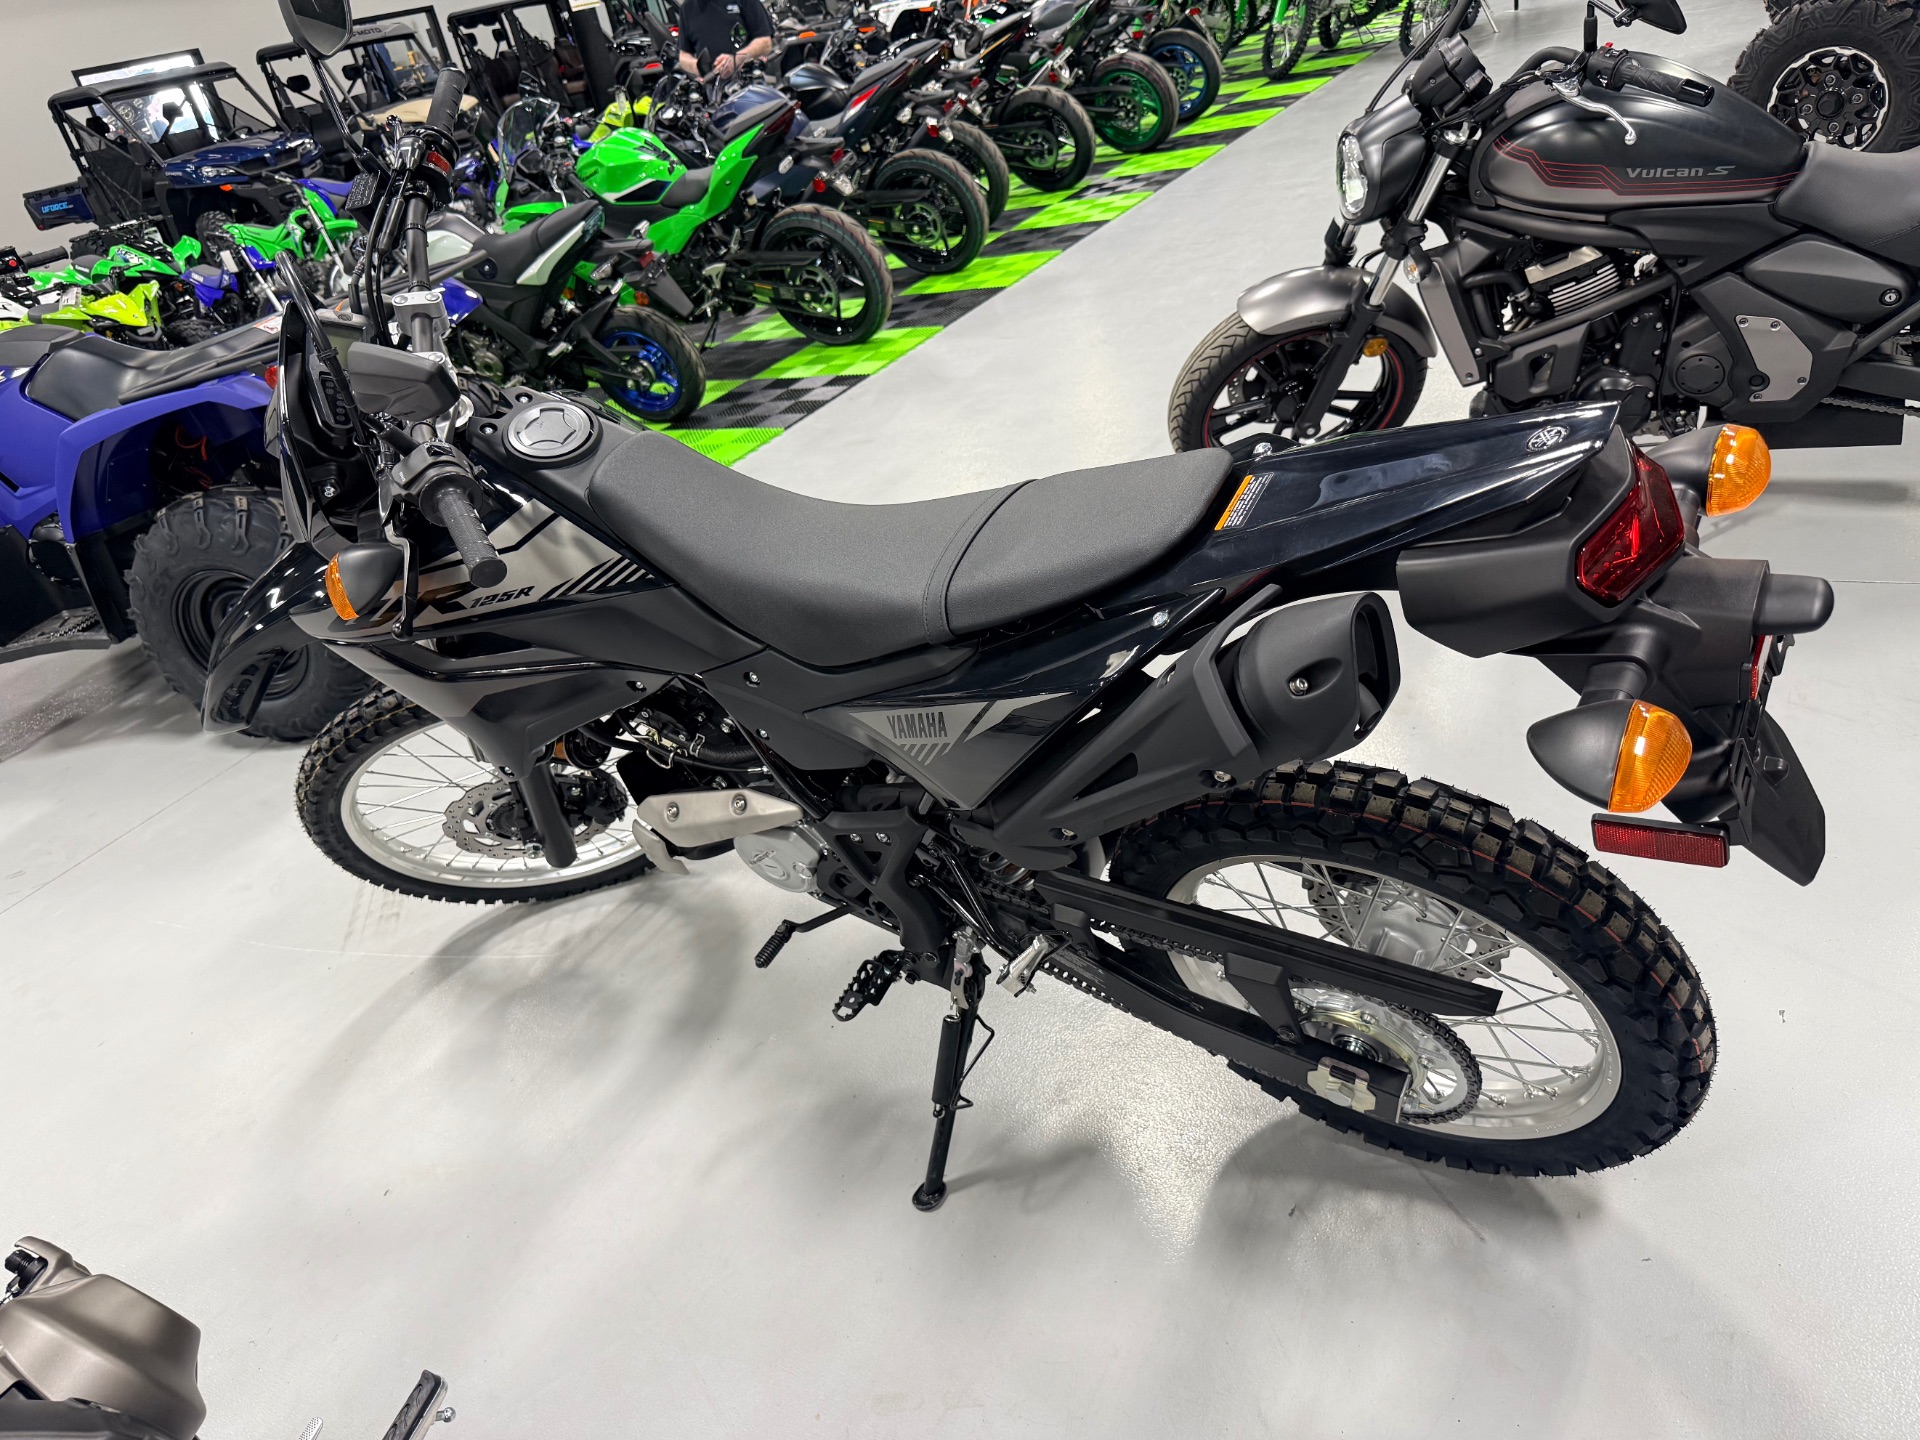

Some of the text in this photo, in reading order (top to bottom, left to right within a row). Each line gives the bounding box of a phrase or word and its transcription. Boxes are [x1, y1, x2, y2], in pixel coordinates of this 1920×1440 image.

[351, 28, 382, 37] FMOTO
[1625, 165, 1736, 178] Vulcan S
[41, 202, 68, 213] UFORCE
[117, 247, 144, 263] KFX
[469, 585, 535, 609] 125R
[886, 711, 948, 739] YAMAHA
